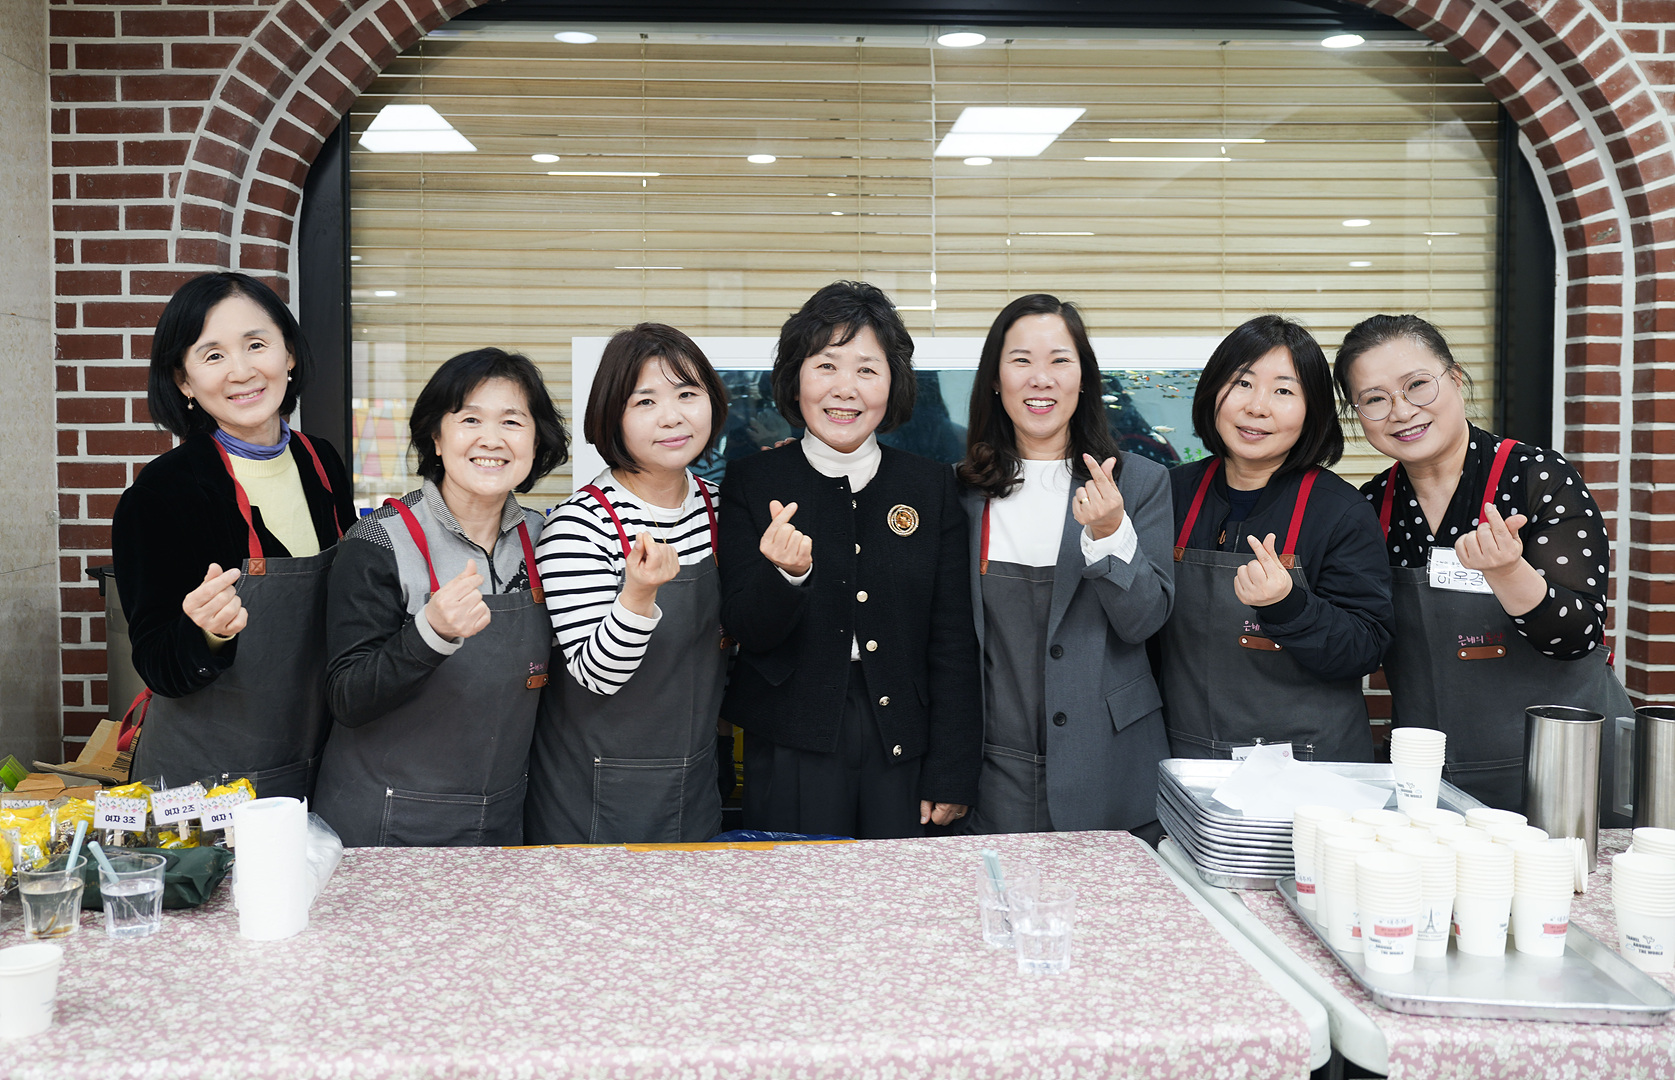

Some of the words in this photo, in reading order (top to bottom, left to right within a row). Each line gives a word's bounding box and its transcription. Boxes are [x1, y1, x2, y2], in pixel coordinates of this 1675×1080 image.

[164, 807, 180, 816] 여자
[182, 804, 196, 813] 2조
[105, 814, 121, 823] 여자
[122, 815, 136, 824] 3조
[211, 813, 227, 823] 여자
